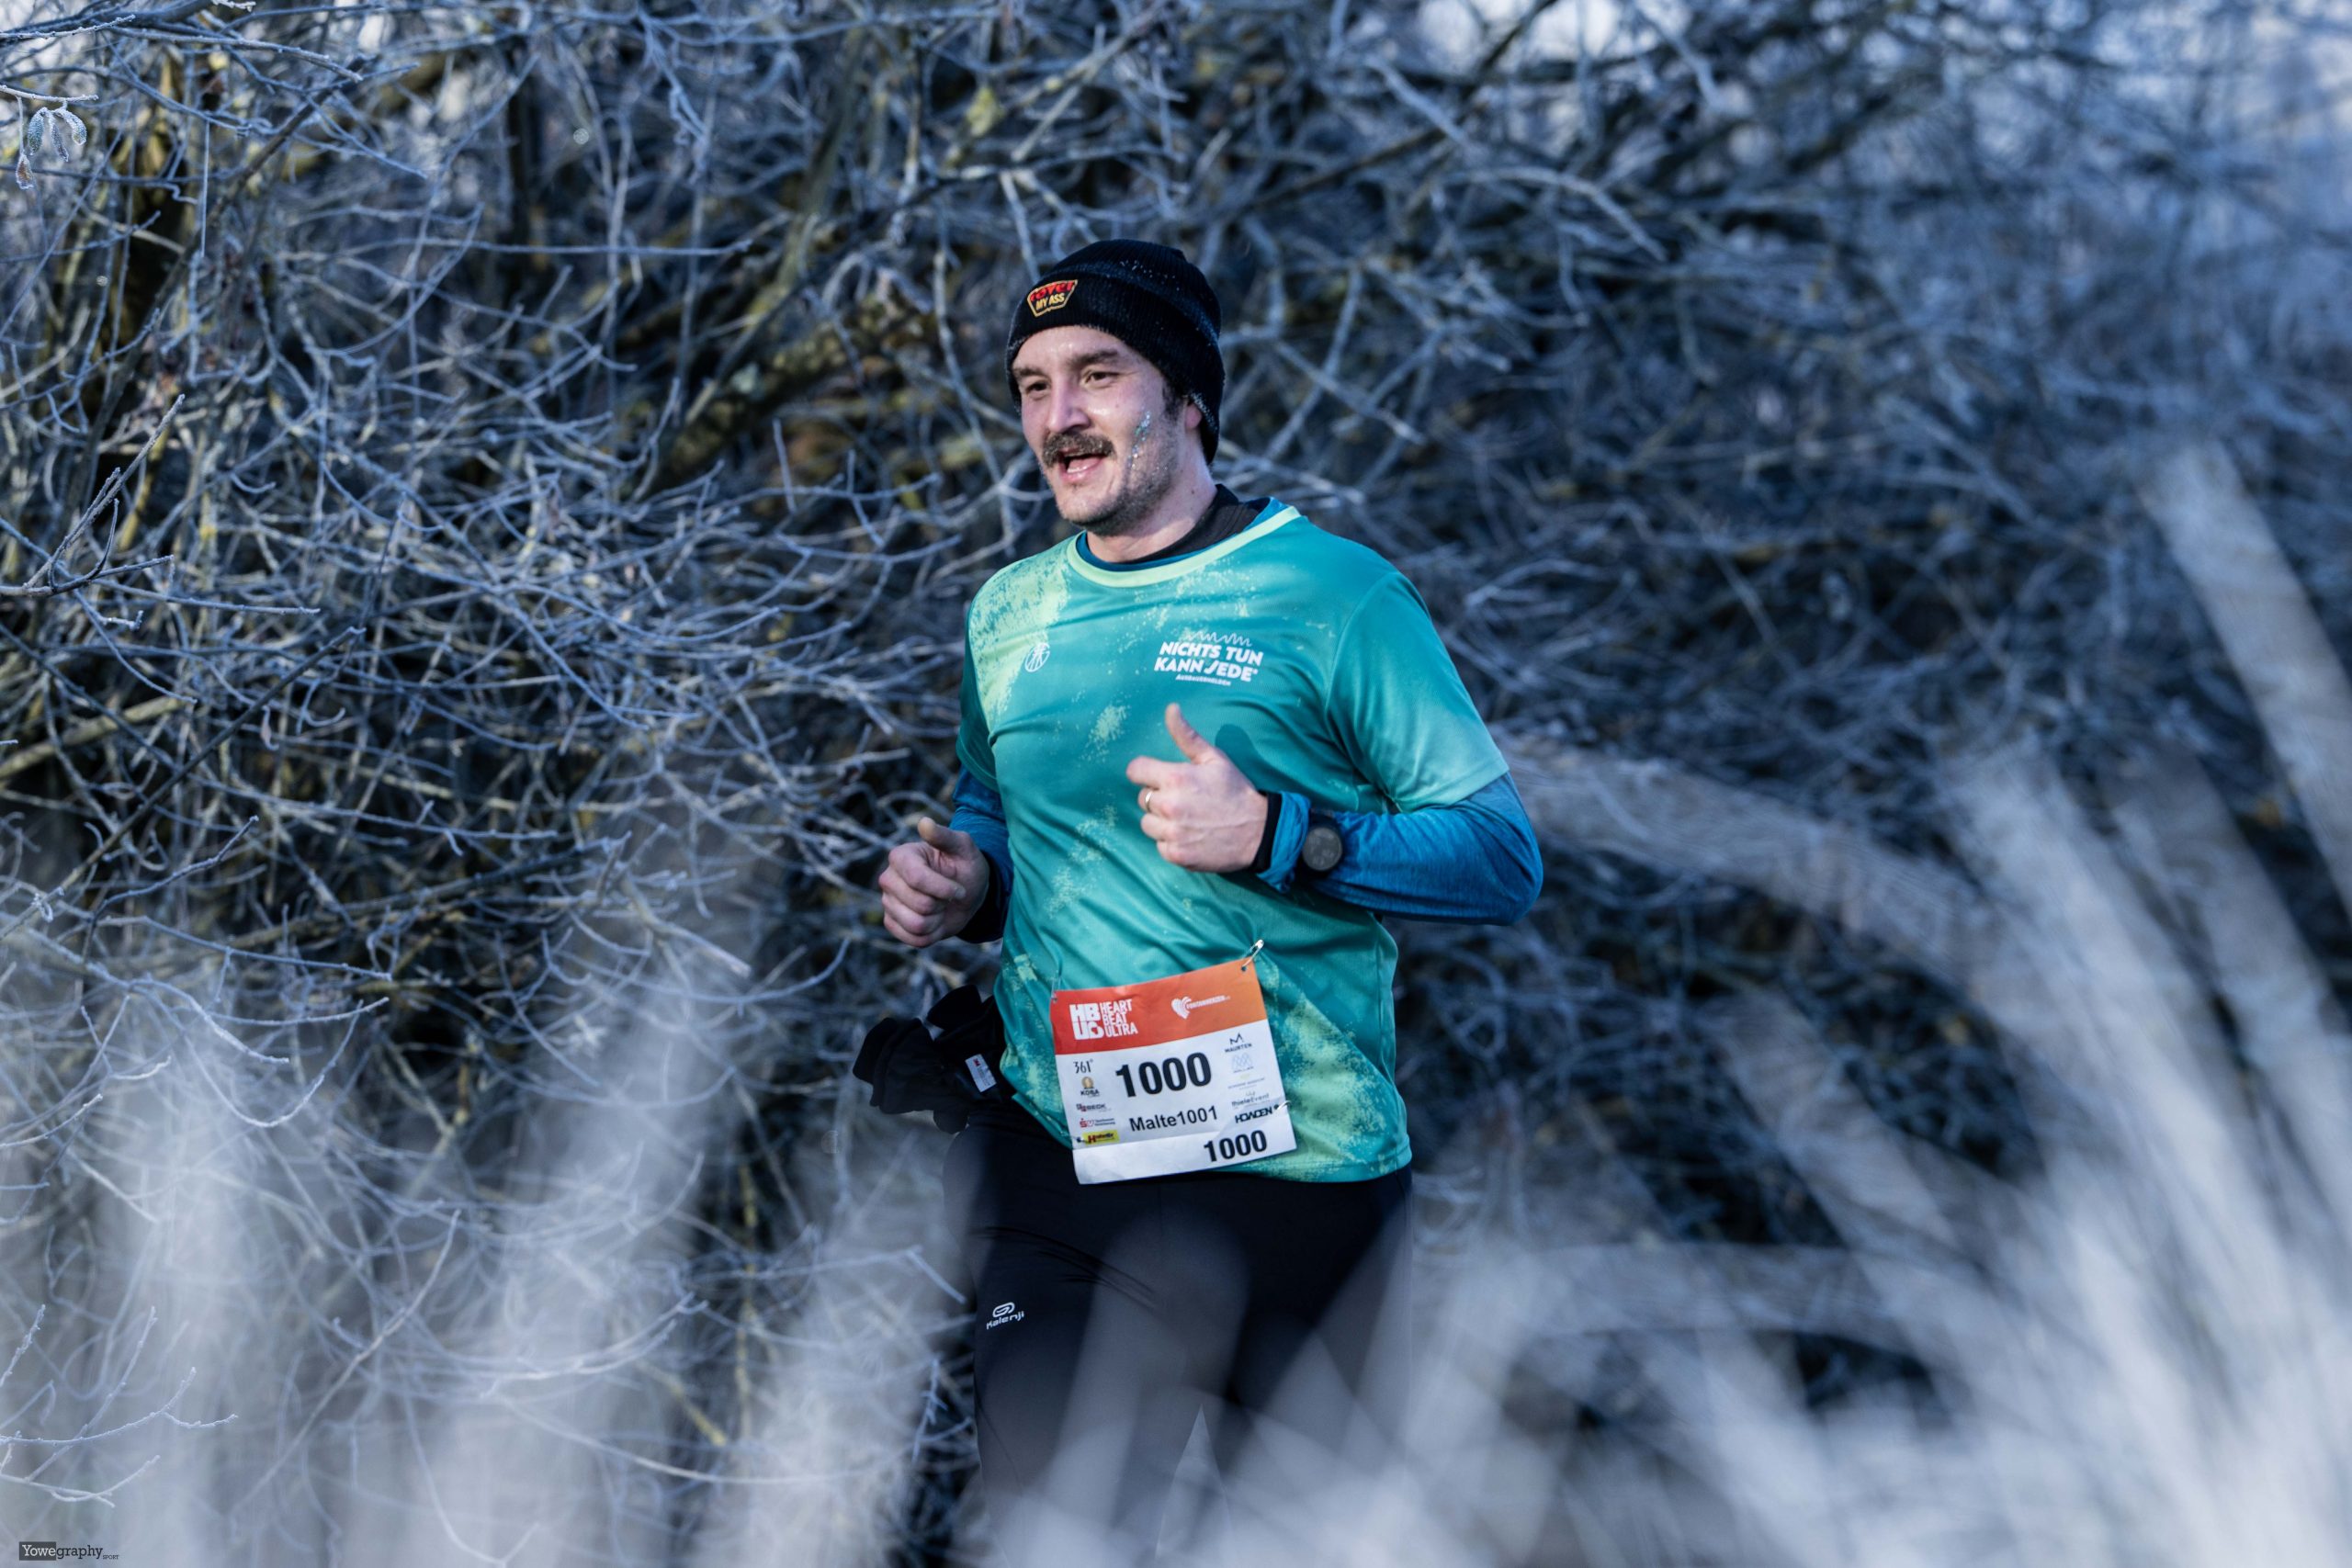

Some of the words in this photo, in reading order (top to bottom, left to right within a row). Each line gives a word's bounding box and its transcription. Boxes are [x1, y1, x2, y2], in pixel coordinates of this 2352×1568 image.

[1036, 298, 1047, 310] MY
[1049, 293, 1065, 305] ASS
[1159, 641, 1222, 659] NICHTS
[1226, 646, 1264, 666] TUN
[1154, 657, 1204, 672] KANN
[1100, 998, 1133, 1016] HEART
[1102, 1011, 1127, 1026] BEAT
[1104, 1021, 1138, 1037] ULTRA
[1115, 1052, 1212, 1098] 1000
[1129, 1105, 1218, 1133] Malte1001
[1204, 1130, 1268, 1162] 1000
